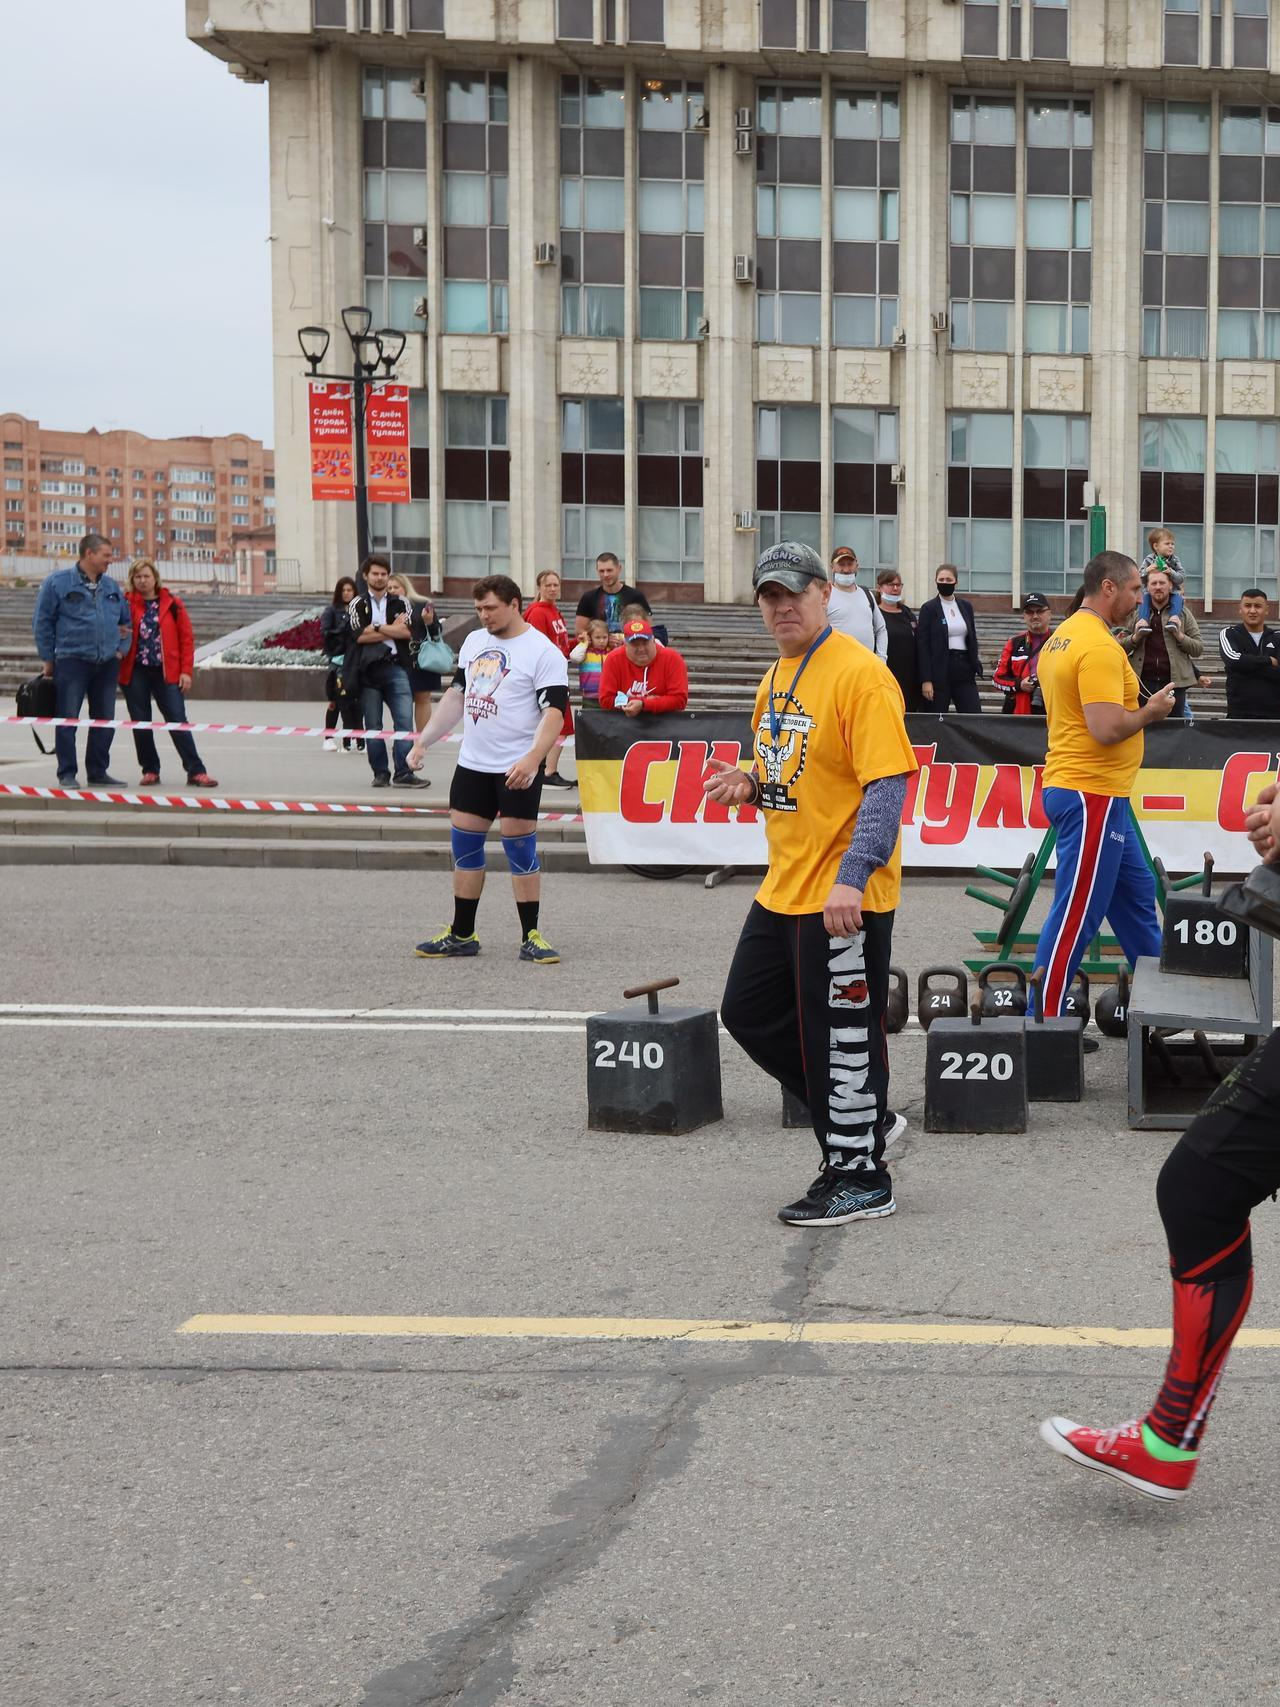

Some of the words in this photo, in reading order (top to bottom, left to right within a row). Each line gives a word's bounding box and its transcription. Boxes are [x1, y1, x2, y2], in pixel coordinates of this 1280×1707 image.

[1173, 919, 1238, 946] 180
[931, 995, 951, 1009] 24
[993, 990, 1013, 1007] 32
[594, 1040, 664, 1069] 240
[939, 1052, 1014, 1081] 220
